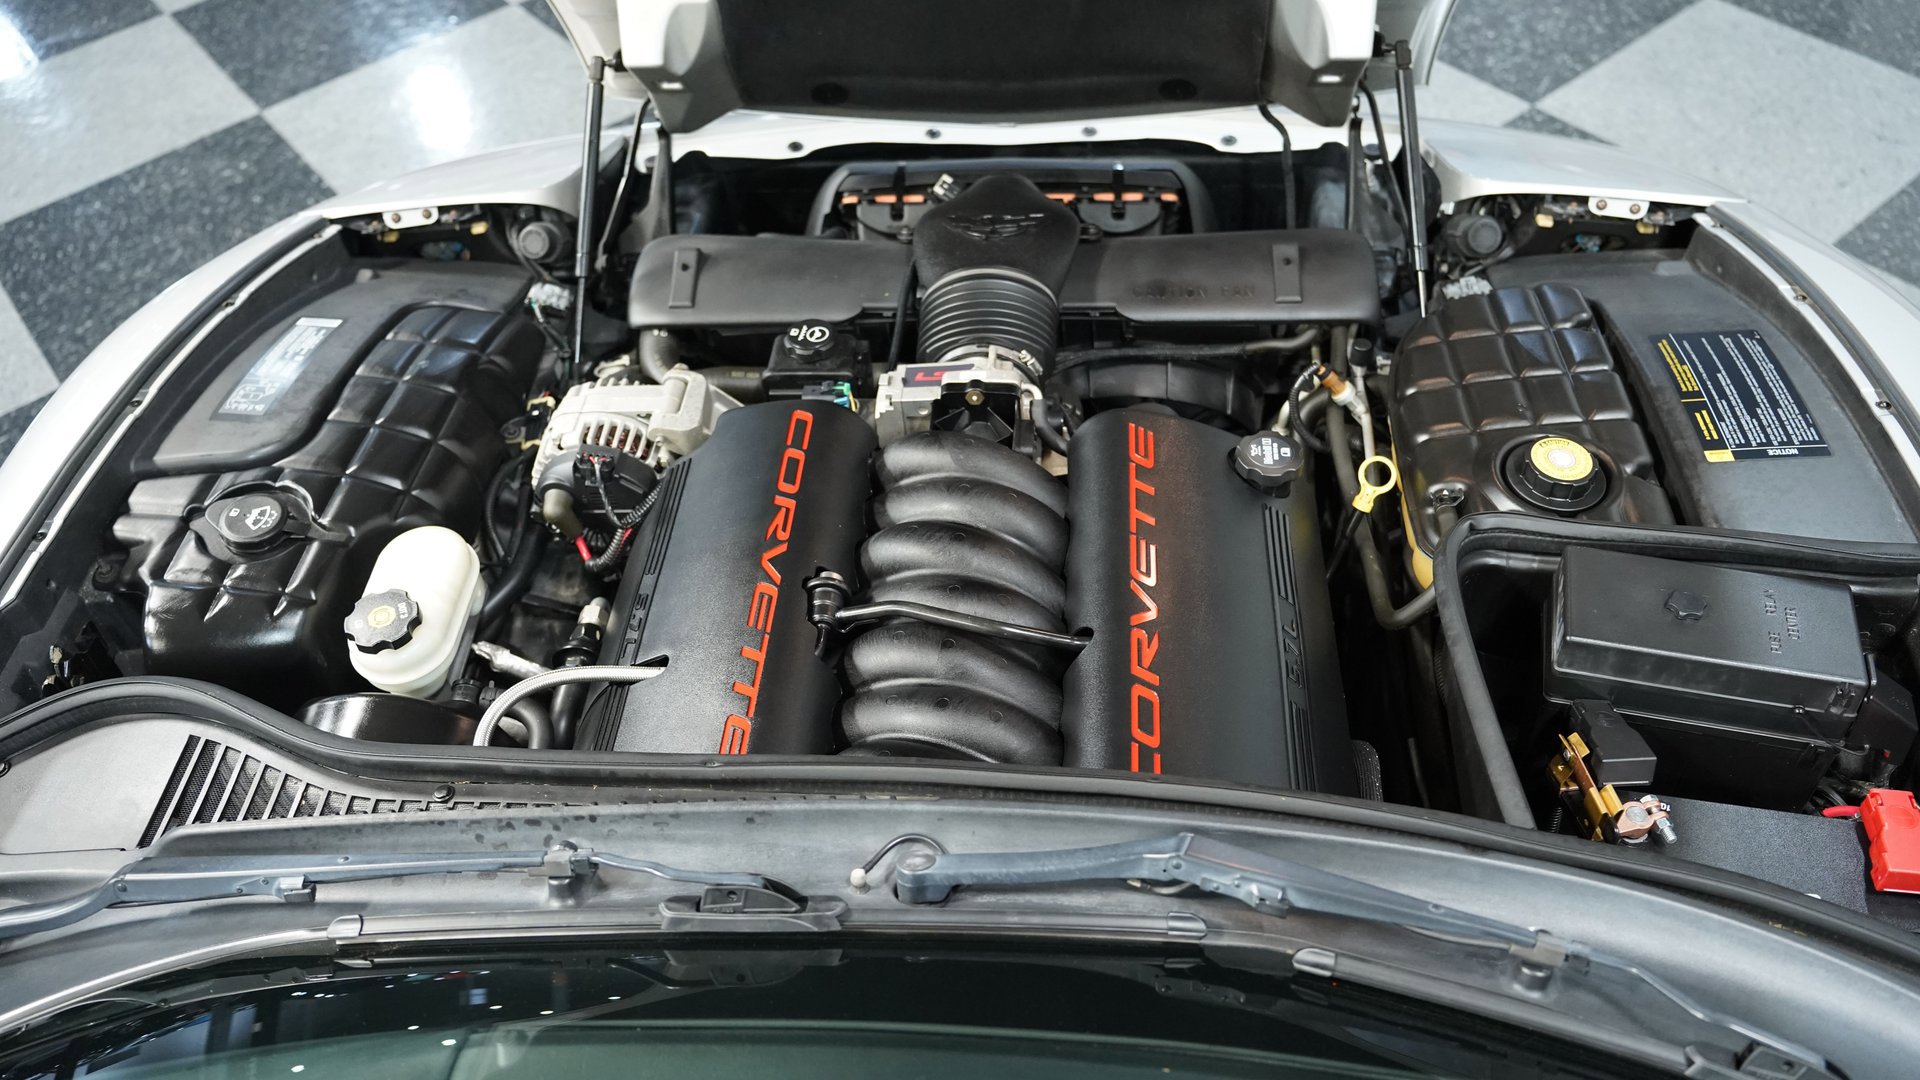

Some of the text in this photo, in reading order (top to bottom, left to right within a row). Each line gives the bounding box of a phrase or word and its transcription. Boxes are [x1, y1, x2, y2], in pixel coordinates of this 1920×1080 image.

[1221, 286, 1255, 299] FAN
[1767, 448, 1799, 456] NOTICE
[720, 410, 813, 755] CORVETTE
[1762, 587, 1782, 654] FUSE RELAY
[1784, 606, 1799, 640] CENTER
